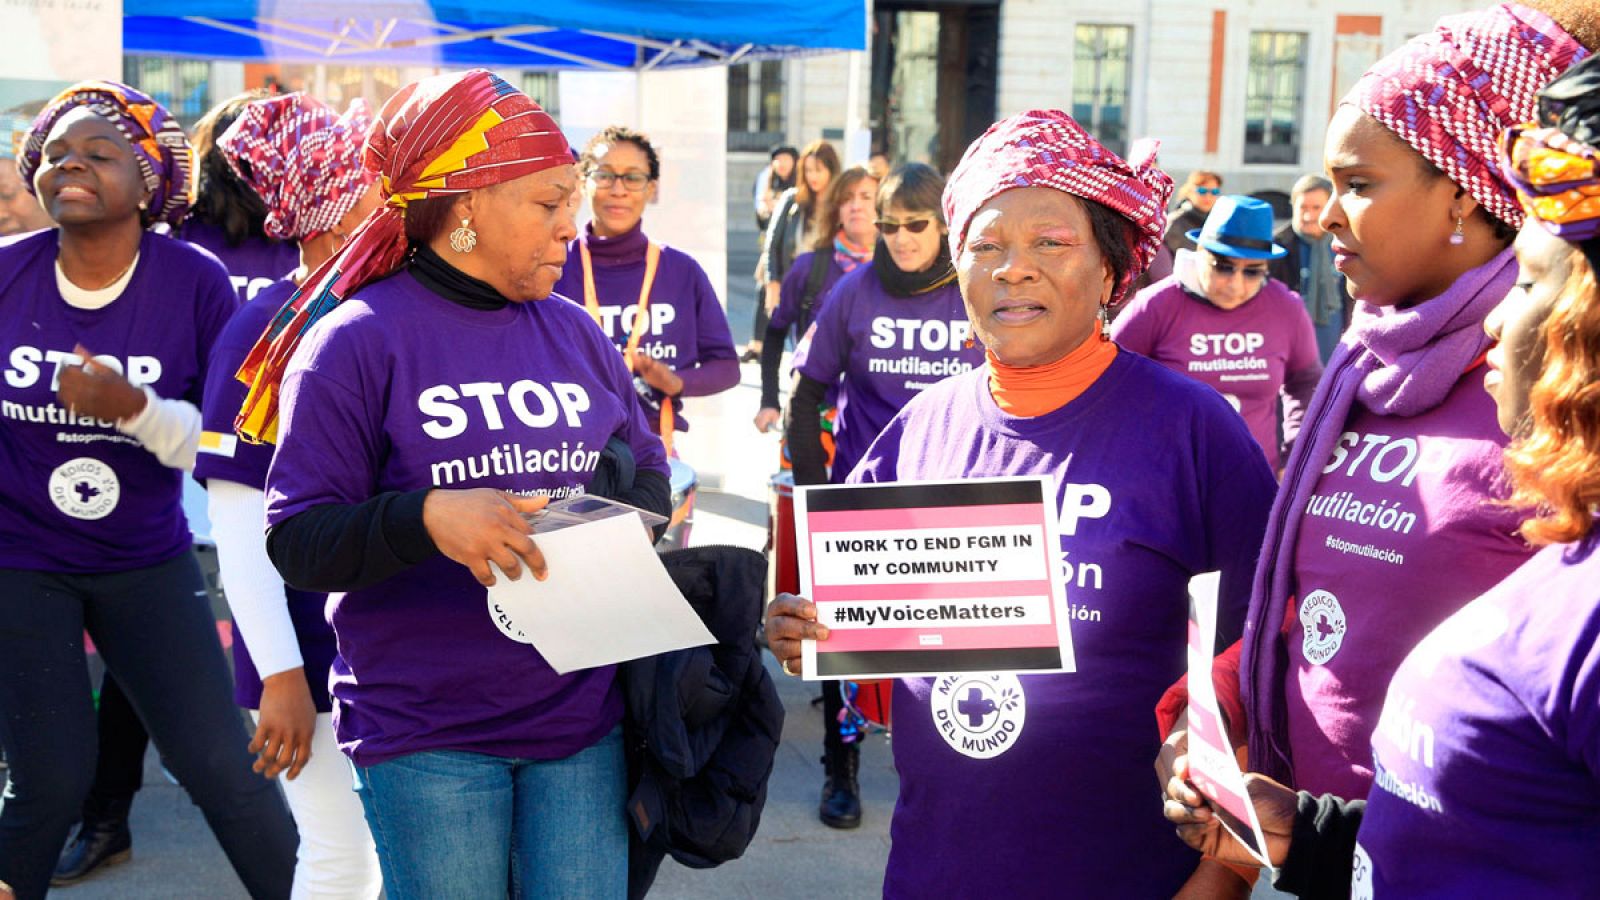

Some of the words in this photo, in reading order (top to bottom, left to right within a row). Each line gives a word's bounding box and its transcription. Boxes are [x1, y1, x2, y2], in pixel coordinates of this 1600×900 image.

[600, 303, 676, 338] TOP
[869, 316, 970, 351] STOP
[1189, 333, 1264, 355] STOP
[868, 356, 973, 376] mutilación
[1188, 356, 1268, 372] mutilación
[418, 380, 590, 439] STOP
[431, 442, 599, 486] mutilación
[825, 540, 830, 553] I
[835, 539, 888, 553] WORK
[893, 538, 918, 551] TO
[924, 537, 961, 550] END
[967, 535, 1006, 549] FGM
[1013, 534, 1032, 547] IN
[1325, 535, 1404, 565] #stopmutilación
[854, 563, 879, 576] MY
[886, 560, 998, 575] COMMUNITY
[834, 604, 1025, 625] #MyVoiceMatters
[936, 709, 956, 741] DEL
[962, 719, 1016, 752] MUNDO
